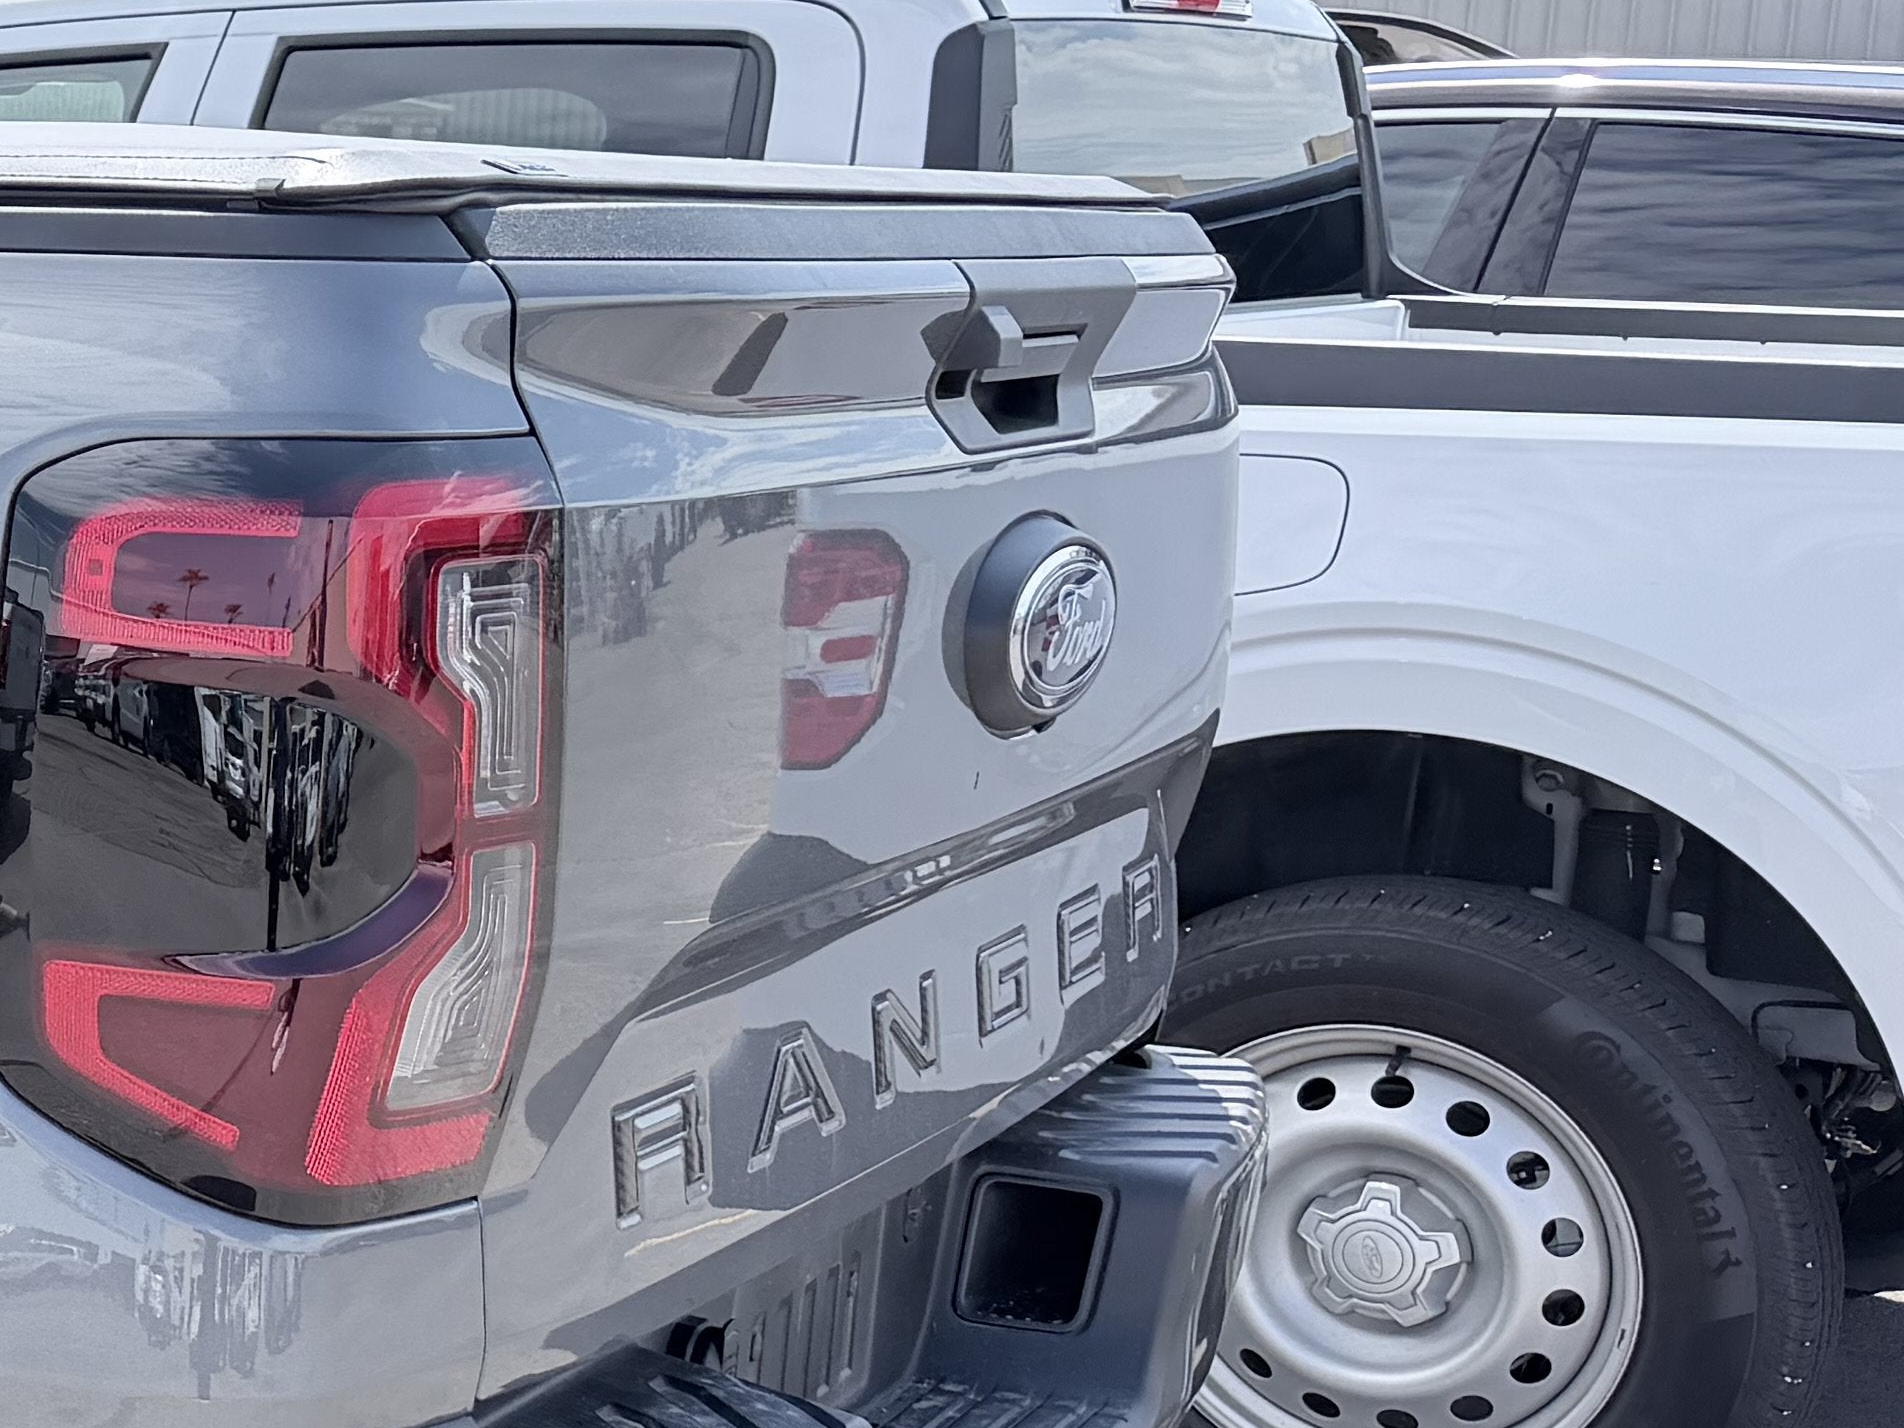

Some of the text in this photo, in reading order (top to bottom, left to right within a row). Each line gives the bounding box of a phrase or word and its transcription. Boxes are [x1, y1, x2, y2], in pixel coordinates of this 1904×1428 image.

[1046, 581, 1107, 672] Ford
[609, 853, 1162, 1231] RANGER
[1573, 1030, 1736, 1246] Continental
